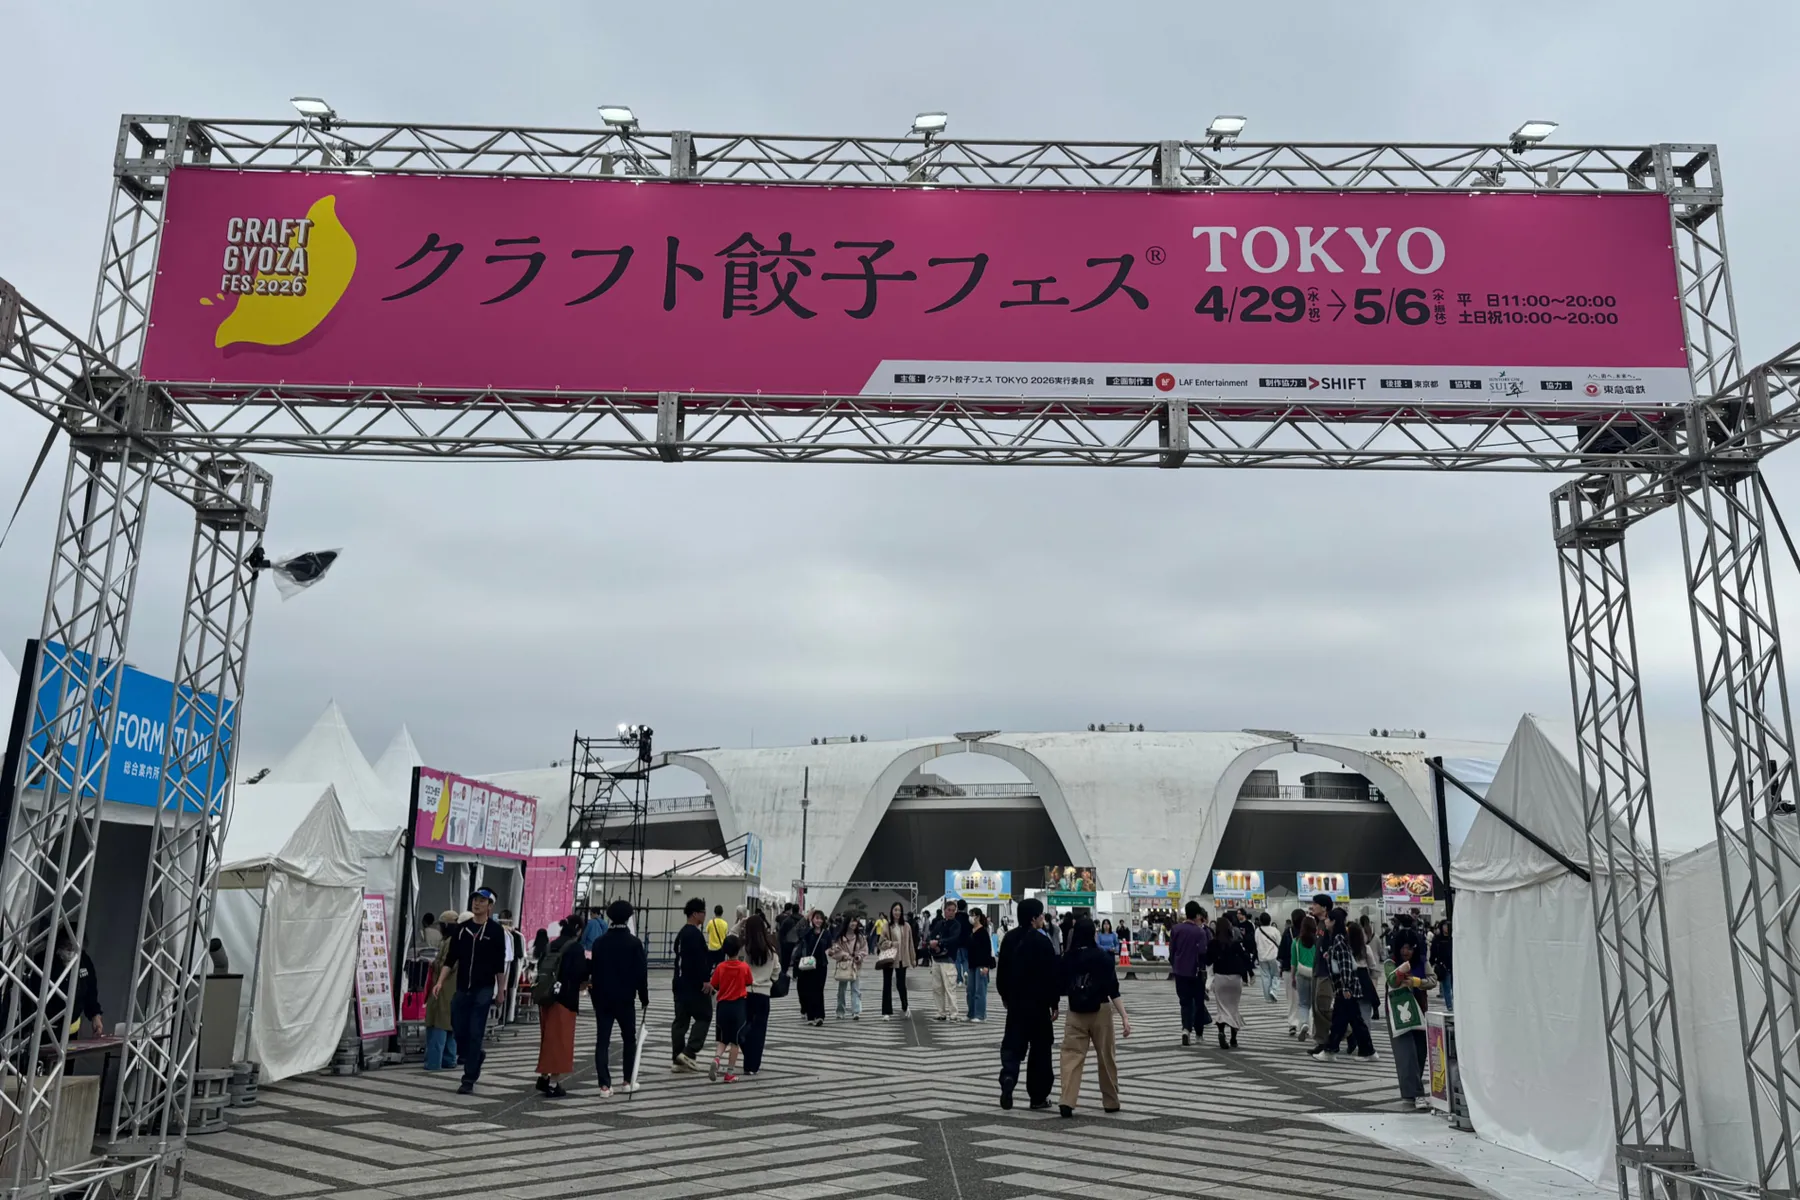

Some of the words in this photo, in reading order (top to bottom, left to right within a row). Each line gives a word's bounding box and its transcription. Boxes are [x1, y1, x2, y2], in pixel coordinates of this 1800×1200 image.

[227, 217, 314, 246] CRAFT
[223, 246, 308, 275] GYOZA
[1192, 226, 1446, 275] TOKYO
[221, 274, 254, 294] FES
[255, 276, 307, 296] 2026
[381, 231, 1149, 320] クラフト餃子フェス
[1194, 285, 1306, 323] 4/29
[1353, 288, 1431, 326] 5/6
[995, 376, 1029, 384] TOKYO
[1179, 378, 1193, 387] LAF
[1195, 378, 1248, 388] Entertainment
[1321, 377, 1367, 391] SHIFT
[1414, 380, 1439, 388] 東京都
[1603, 385, 1646, 395] 東急電鉄
[123, 760, 161, 780] 総合案内所
